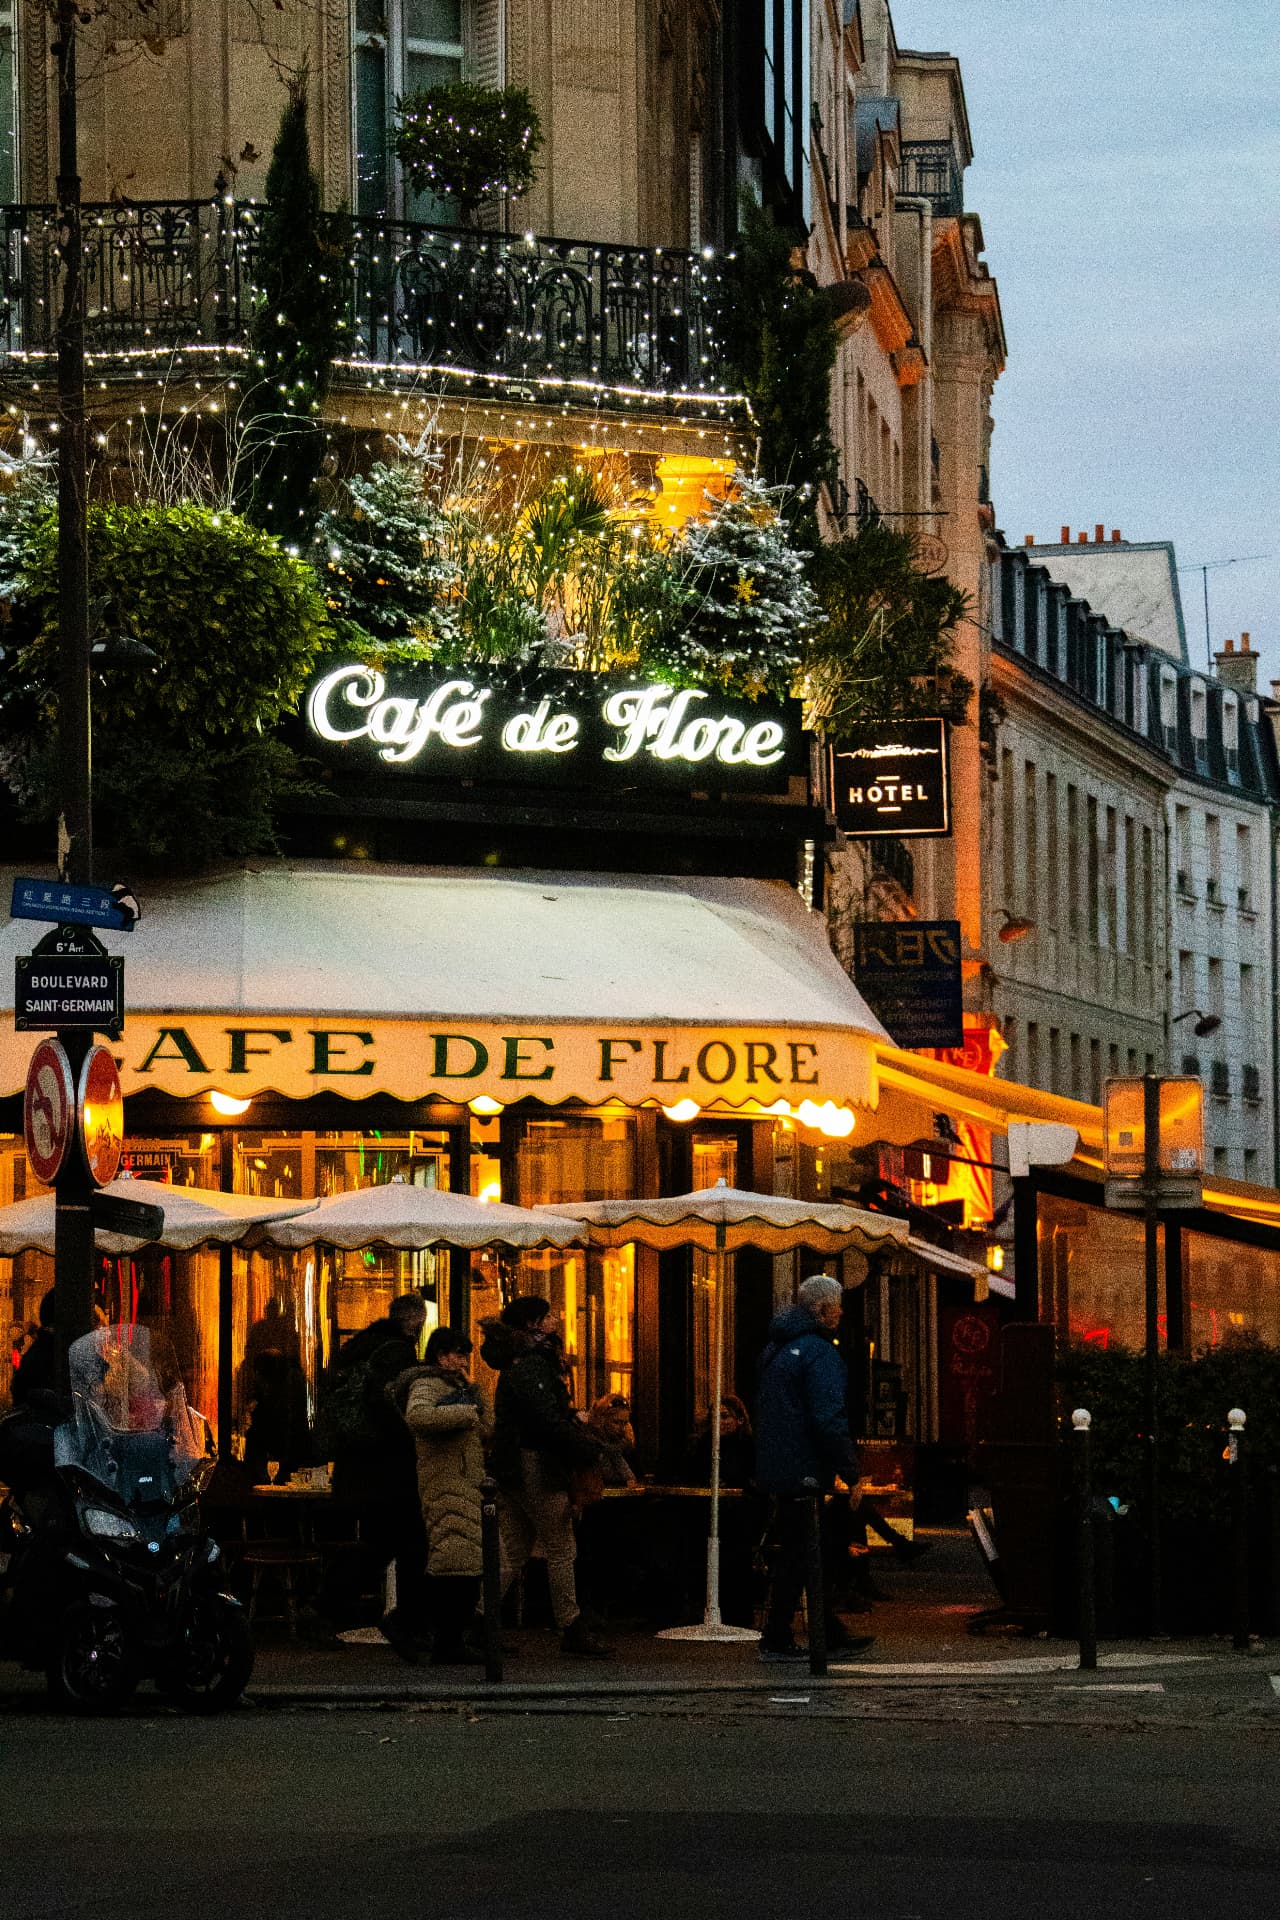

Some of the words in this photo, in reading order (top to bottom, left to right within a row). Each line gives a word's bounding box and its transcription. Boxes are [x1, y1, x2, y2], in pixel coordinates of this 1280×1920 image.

[308, 664, 491, 762] Café
[502, 700, 579, 753] de
[602, 684, 786, 766] Flore
[31, 976, 109, 988] BOULEVARD
[25, 999, 114, 1012] SAINT-GERMAIN
[429, 1034, 555, 1081] DE
[598, 1038, 820, 1085] FLORE
